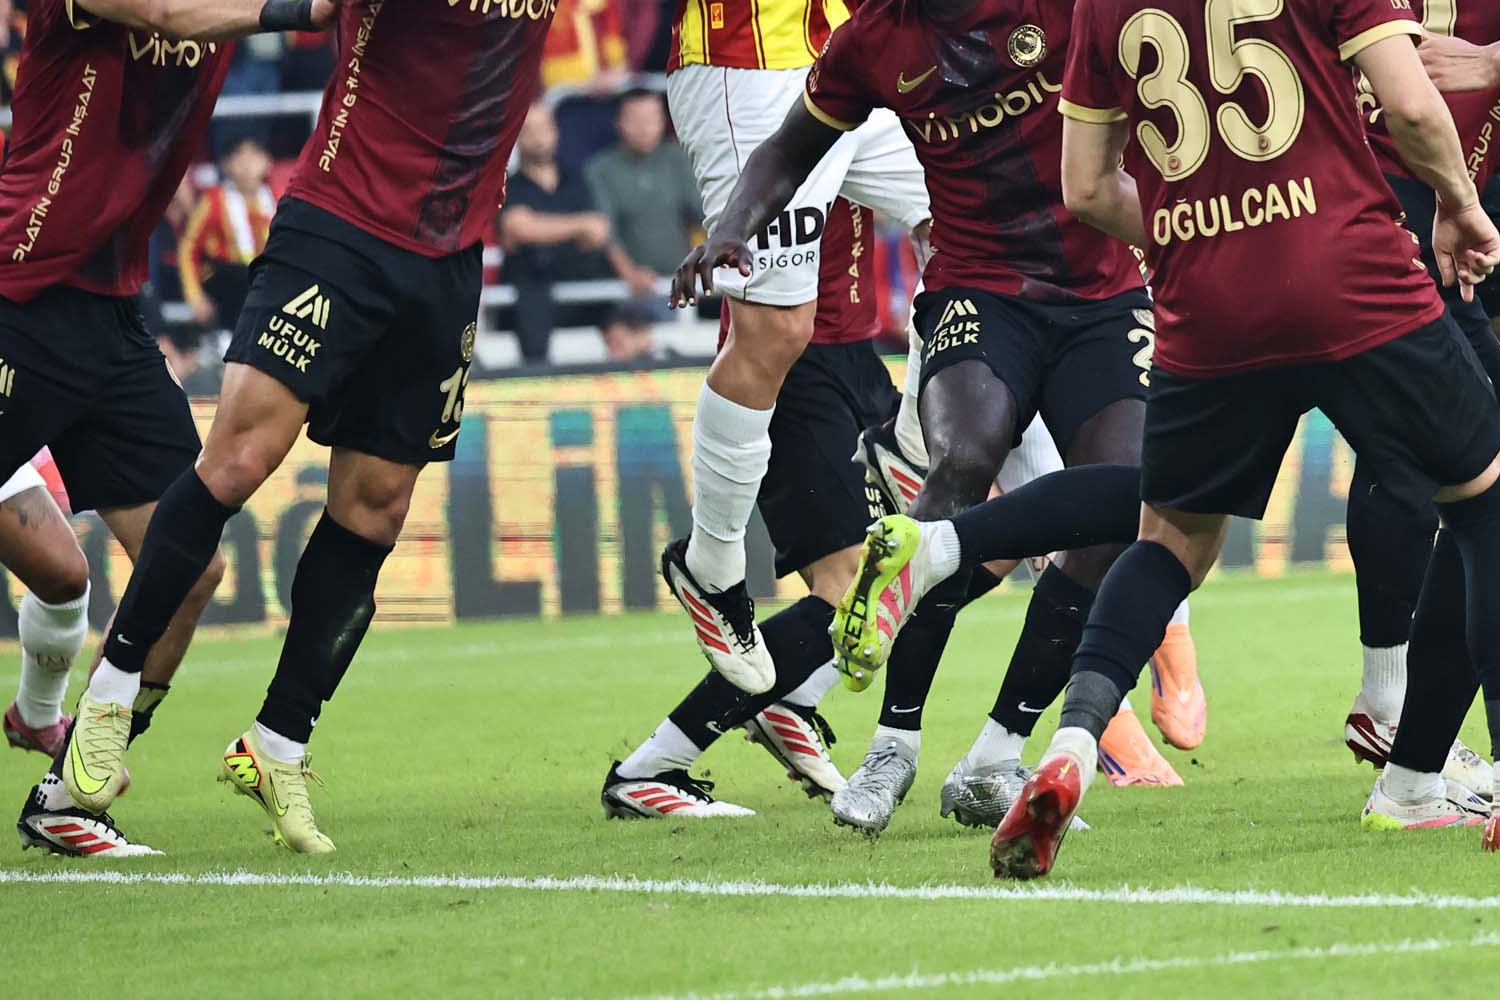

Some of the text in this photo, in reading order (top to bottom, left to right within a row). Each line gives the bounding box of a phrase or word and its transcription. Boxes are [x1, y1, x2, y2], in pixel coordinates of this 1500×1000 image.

[13, 64, 97, 262] PLATİN GRUP İNŞAAT
[1153, 177, 1318, 245] OĞULCAN
[759, 250, 817, 270] SİGOR
[257, 332, 311, 373] MÜLK
[268, 315, 321, 357] UFUK
[925, 332, 978, 363] MÜLK
[928, 320, 980, 350] UFUK
